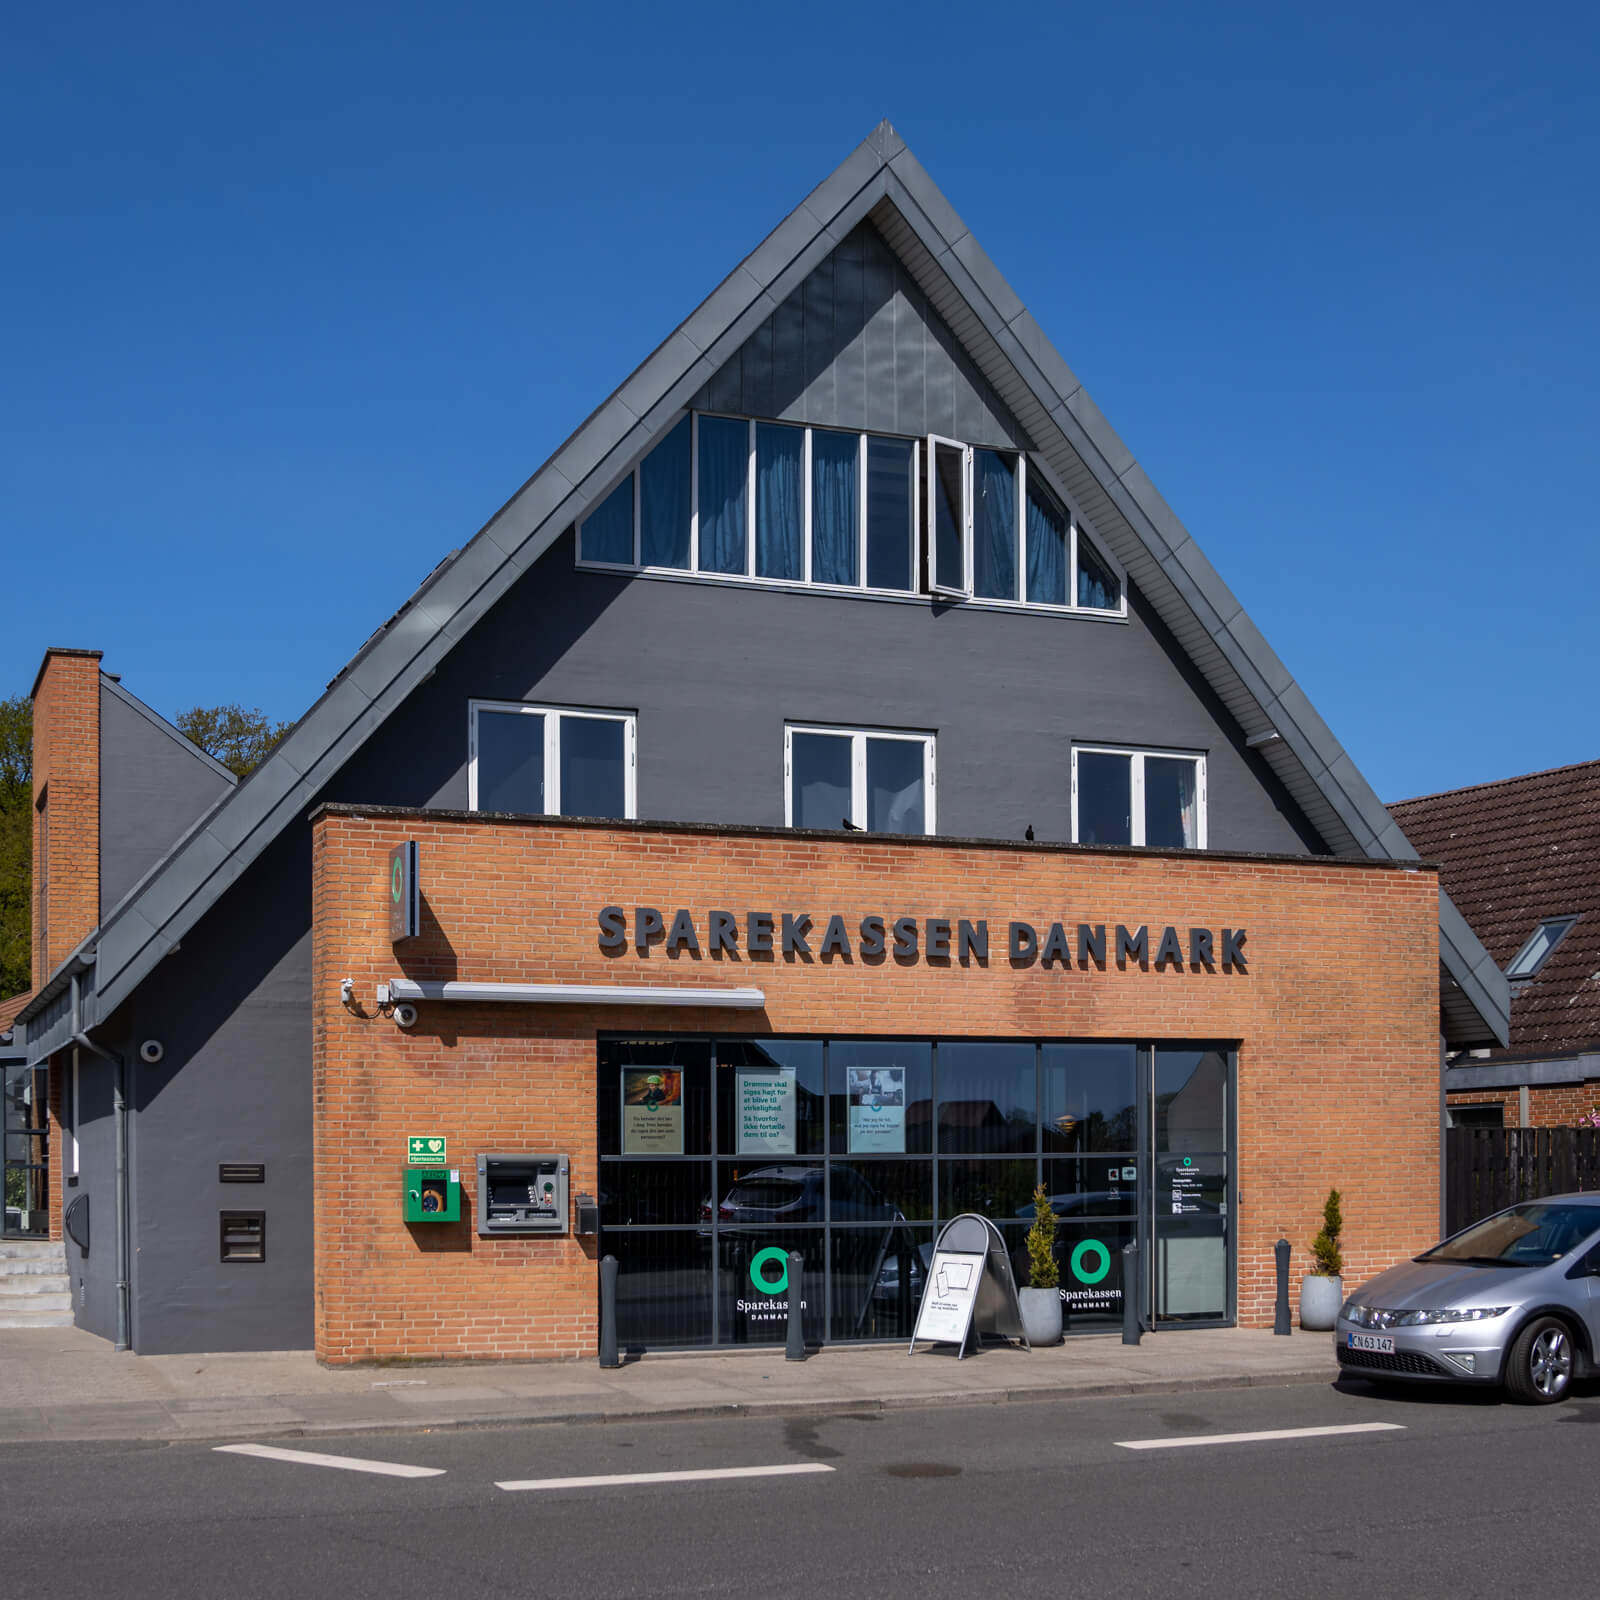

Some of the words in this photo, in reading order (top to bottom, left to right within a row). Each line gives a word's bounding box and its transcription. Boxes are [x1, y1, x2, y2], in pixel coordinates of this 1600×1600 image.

[598, 905, 989, 959] SPAREKASSEN
[1008, 921, 1249, 965] DANMARK
[1060, 1288, 1122, 1302] Sparekassen
[736, 1299, 807, 1313] Sparekasn
[751, 1313, 788, 1321] DANMAR
[1377, 1338, 1392, 1351] 147
